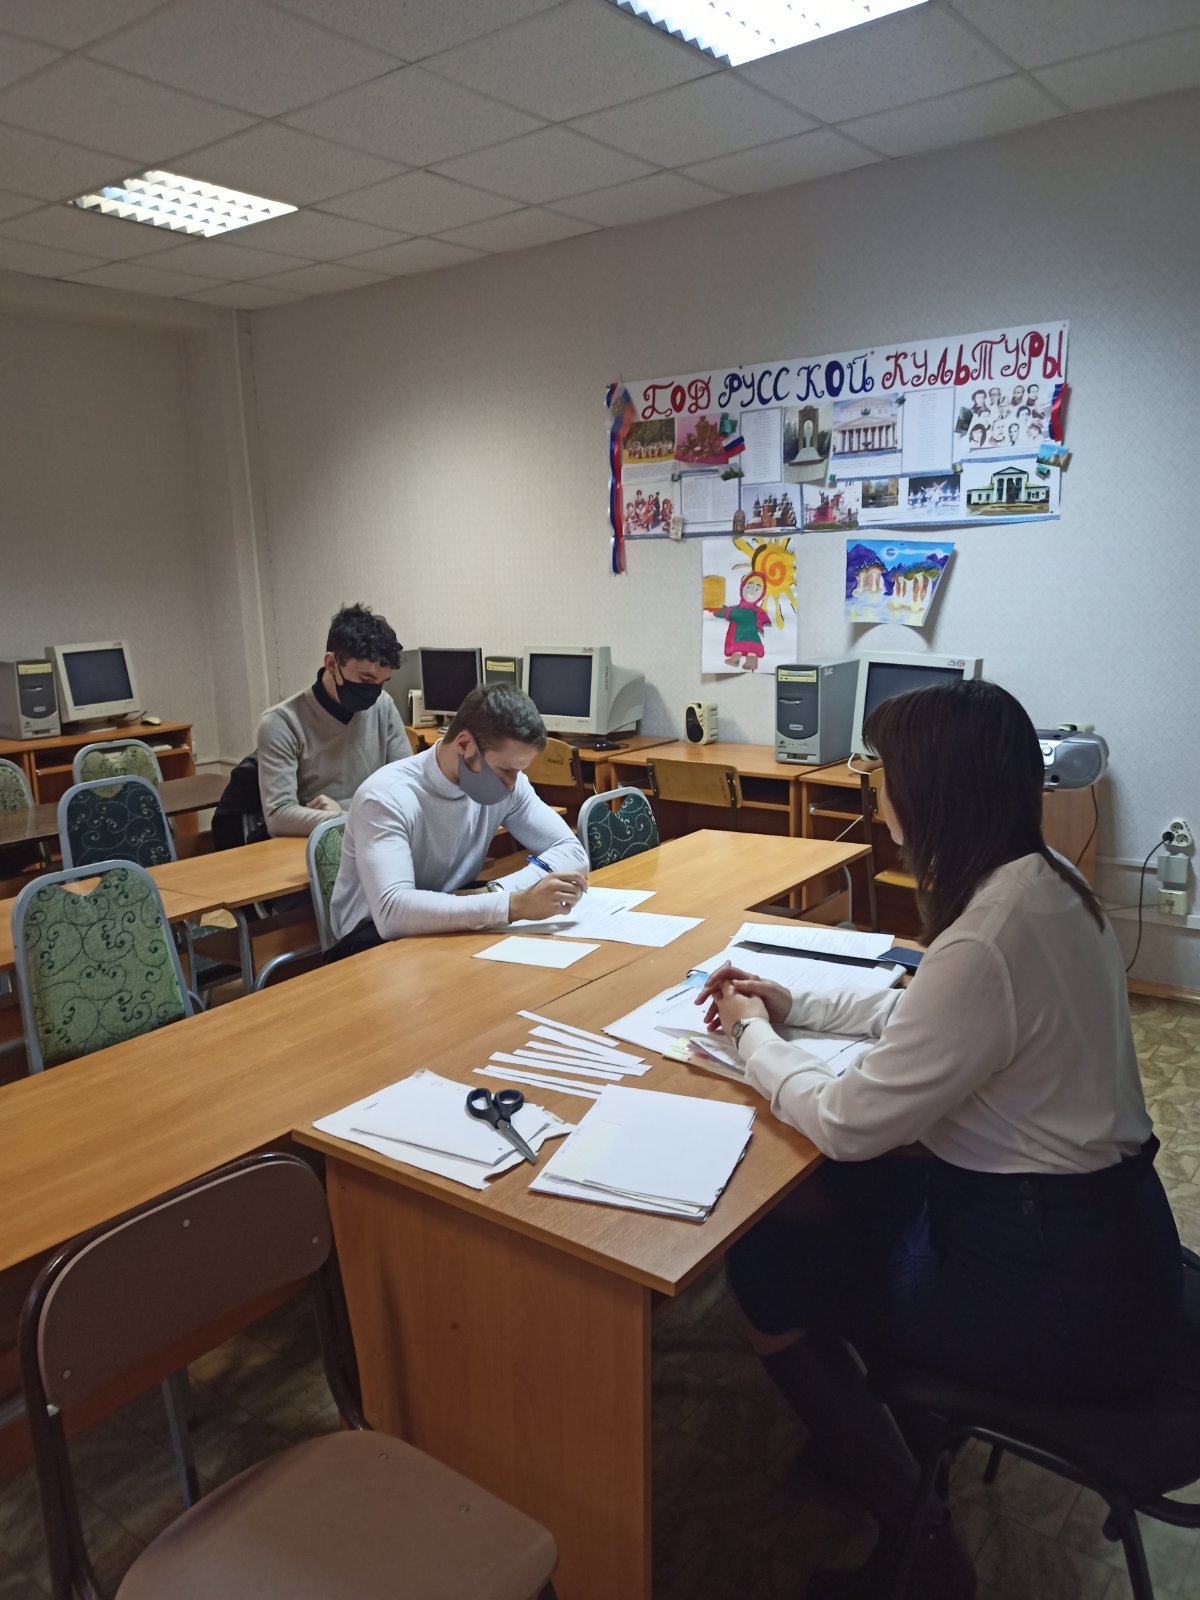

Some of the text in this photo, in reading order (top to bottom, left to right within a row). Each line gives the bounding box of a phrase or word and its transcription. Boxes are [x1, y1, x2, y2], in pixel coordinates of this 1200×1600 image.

[641, 329, 1063, 420] ГОД РУССКОЙ КУЛЬТУРЫ
